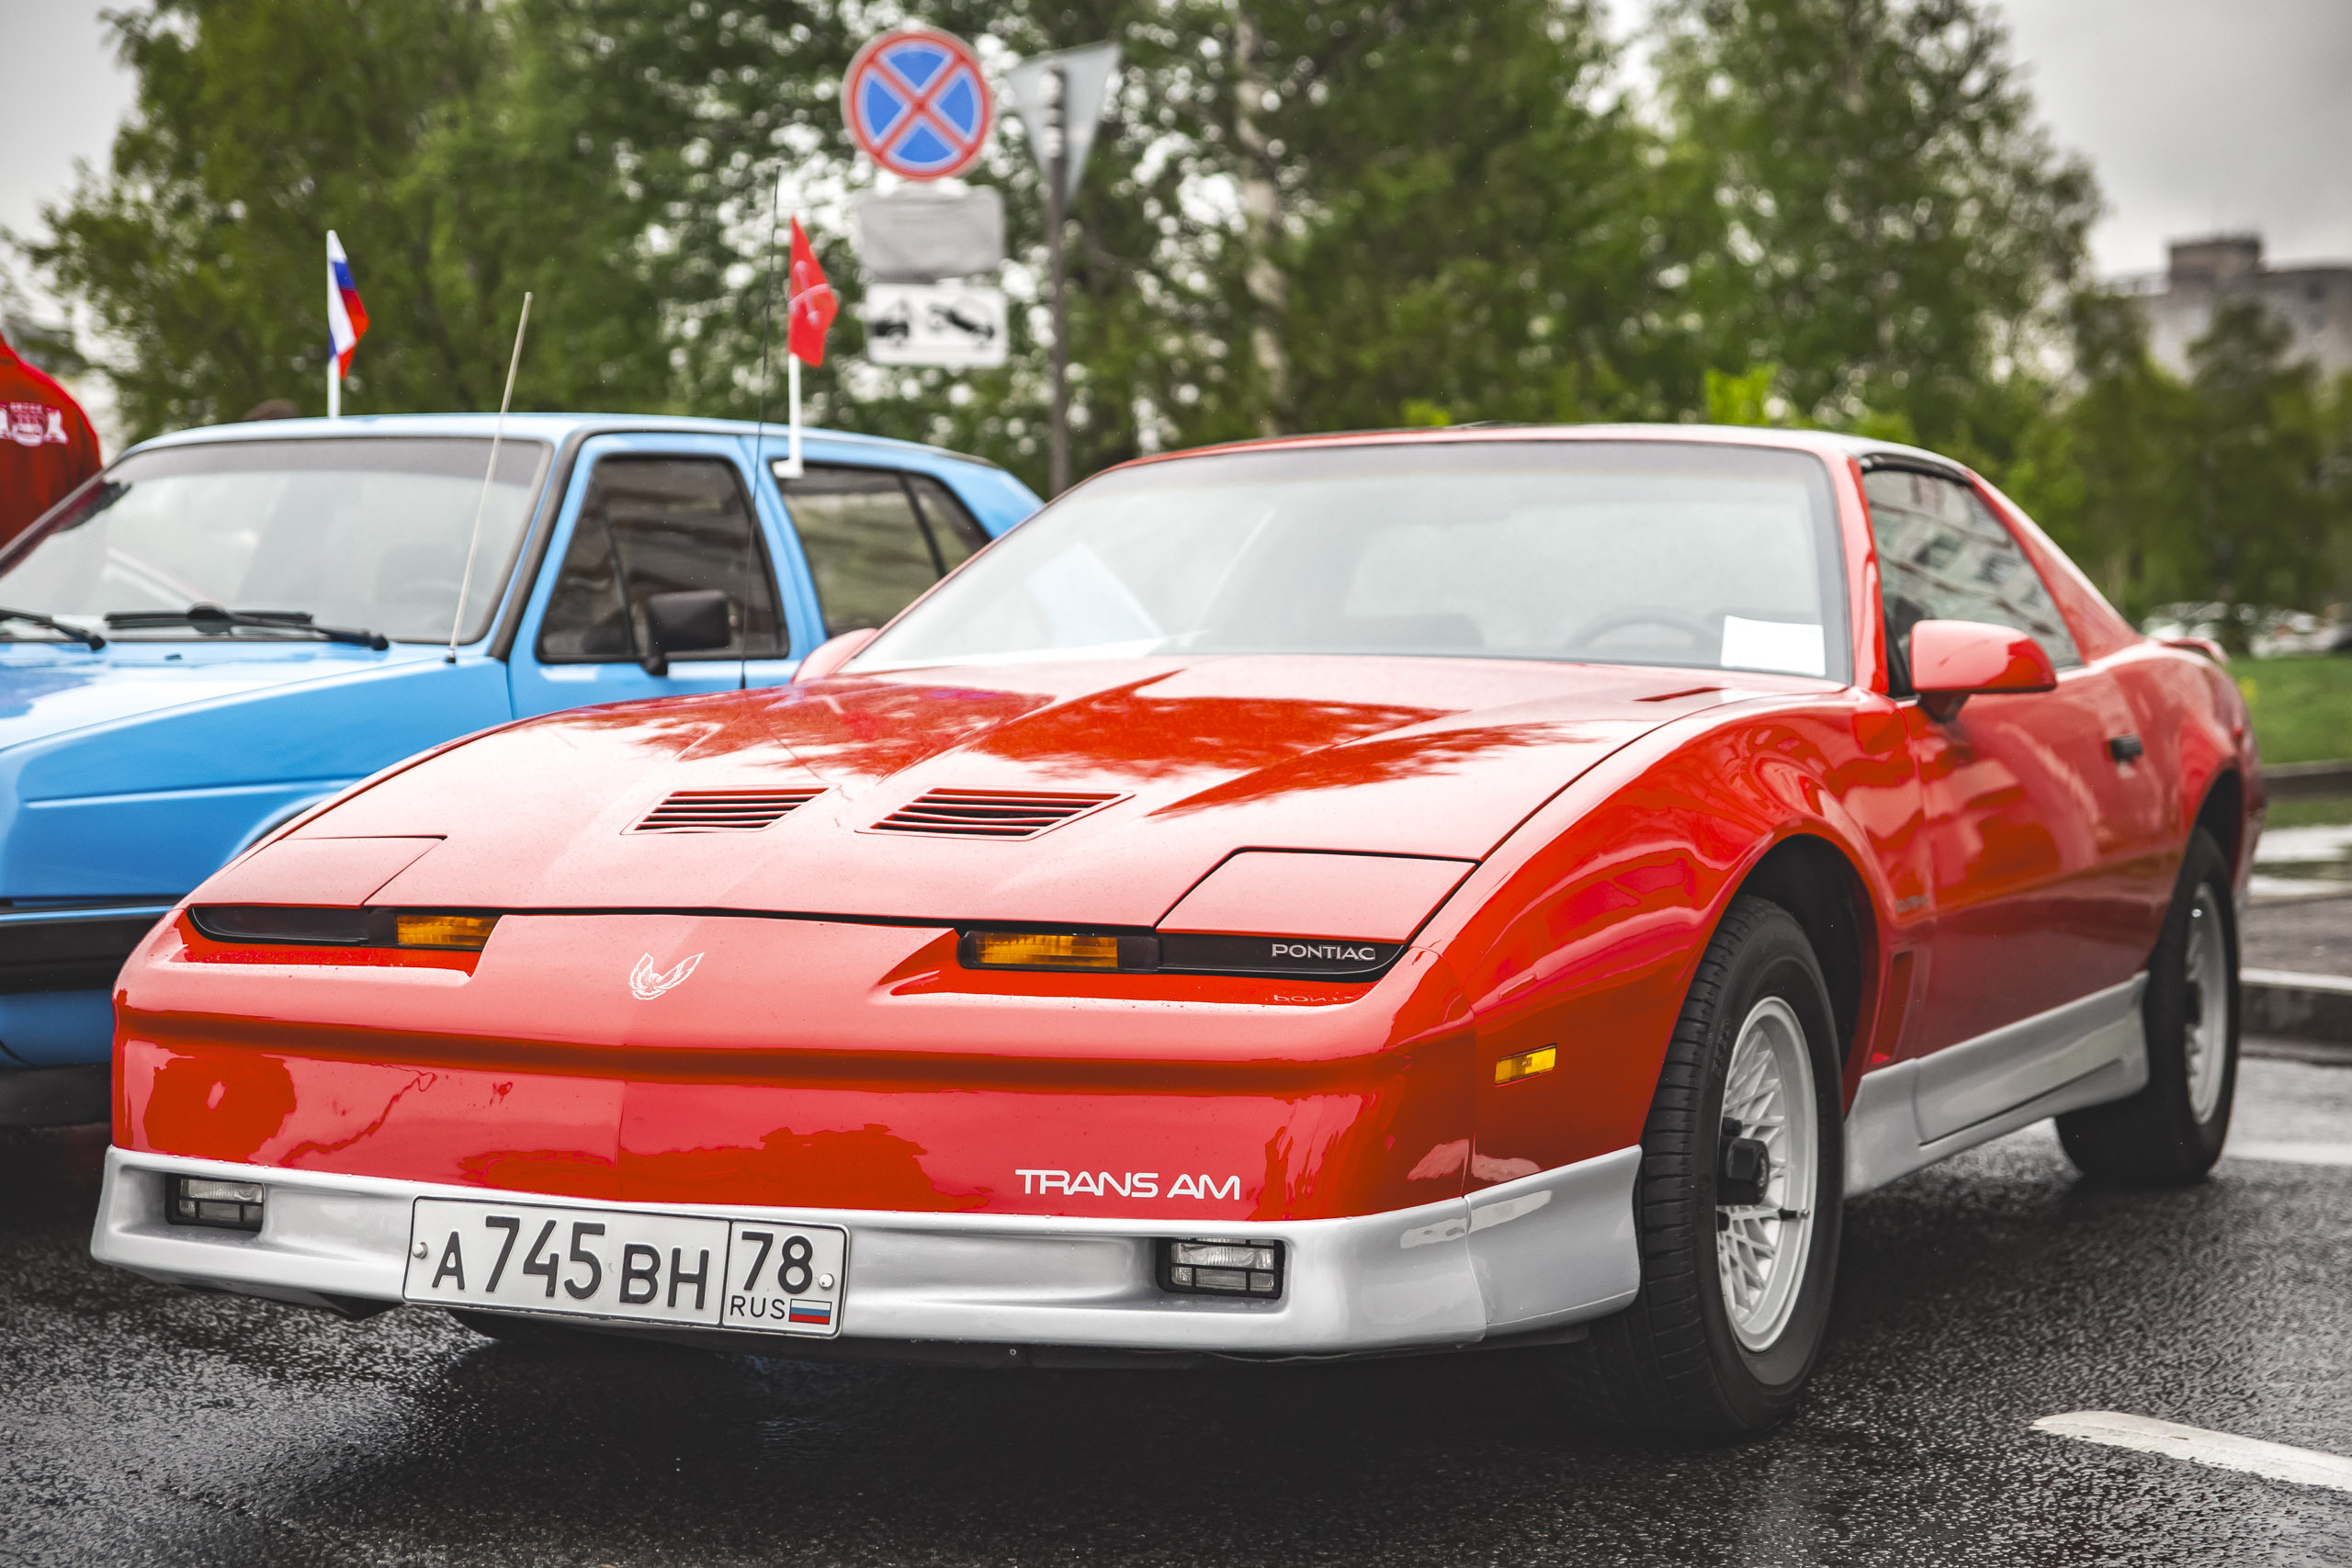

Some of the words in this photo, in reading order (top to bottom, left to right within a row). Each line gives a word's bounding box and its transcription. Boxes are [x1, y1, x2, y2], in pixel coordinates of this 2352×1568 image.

[1272, 943, 1376, 961] PONTIAC
[1015, 1169, 1159, 1198] TRANS
[1167, 1174, 1240, 1201] AM
[741, 1231, 814, 1295] 78
[730, 1295, 786, 1320] RUS
